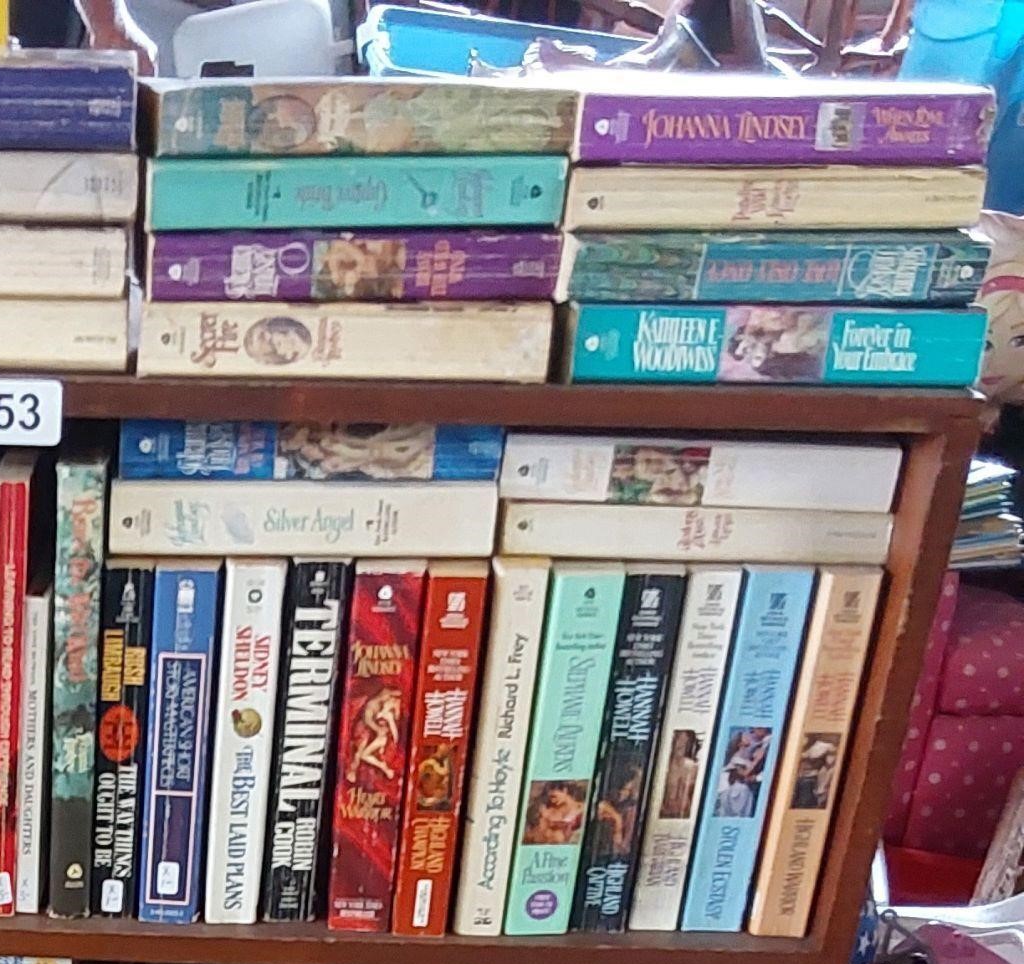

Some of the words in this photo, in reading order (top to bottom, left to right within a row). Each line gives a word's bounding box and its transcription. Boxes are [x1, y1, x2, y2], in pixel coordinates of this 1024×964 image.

[642, 109, 730, 150] JOHANNA
[738, 111, 809, 145] LINDSEY
[264, 508, 307, 531] Silver
[312, 508, 355, 544] Angel
[232, 624, 253, 701] SHELDON
[251, 634, 271, 691] SIDNEY
[505, 666, 518, 678] L.
[511, 632, 530, 665] Frey
[278, 599, 339, 814] TERMINAL
[423, 690, 445, 739] HOWELL
[440, 687, 468, 741] HANNAH
[498, 682, 521, 738] Richard
[611, 679, 637, 742] HOWELL
[627, 671, 661, 743] HANNAH
[120, 765, 138, 794] THE
[491, 747, 512, 792] Hoyle
[97, 772, 117, 824] OUGHT
[117, 796, 135, 828] WAY
[229, 775, 256, 819] BEST
[489, 795, 506, 812] To
[94, 845, 111, 868] BE
[95, 825, 112, 844] TO
[111, 828, 134, 878] THINGS
[226, 822, 248, 859] LAID
[271, 822, 295, 869] COOK
[292, 816, 317, 871] ROBIN
[480, 814, 508, 890] According
[714, 826, 741, 869] STOLEN
[223, 862, 244, 911] PLANS
